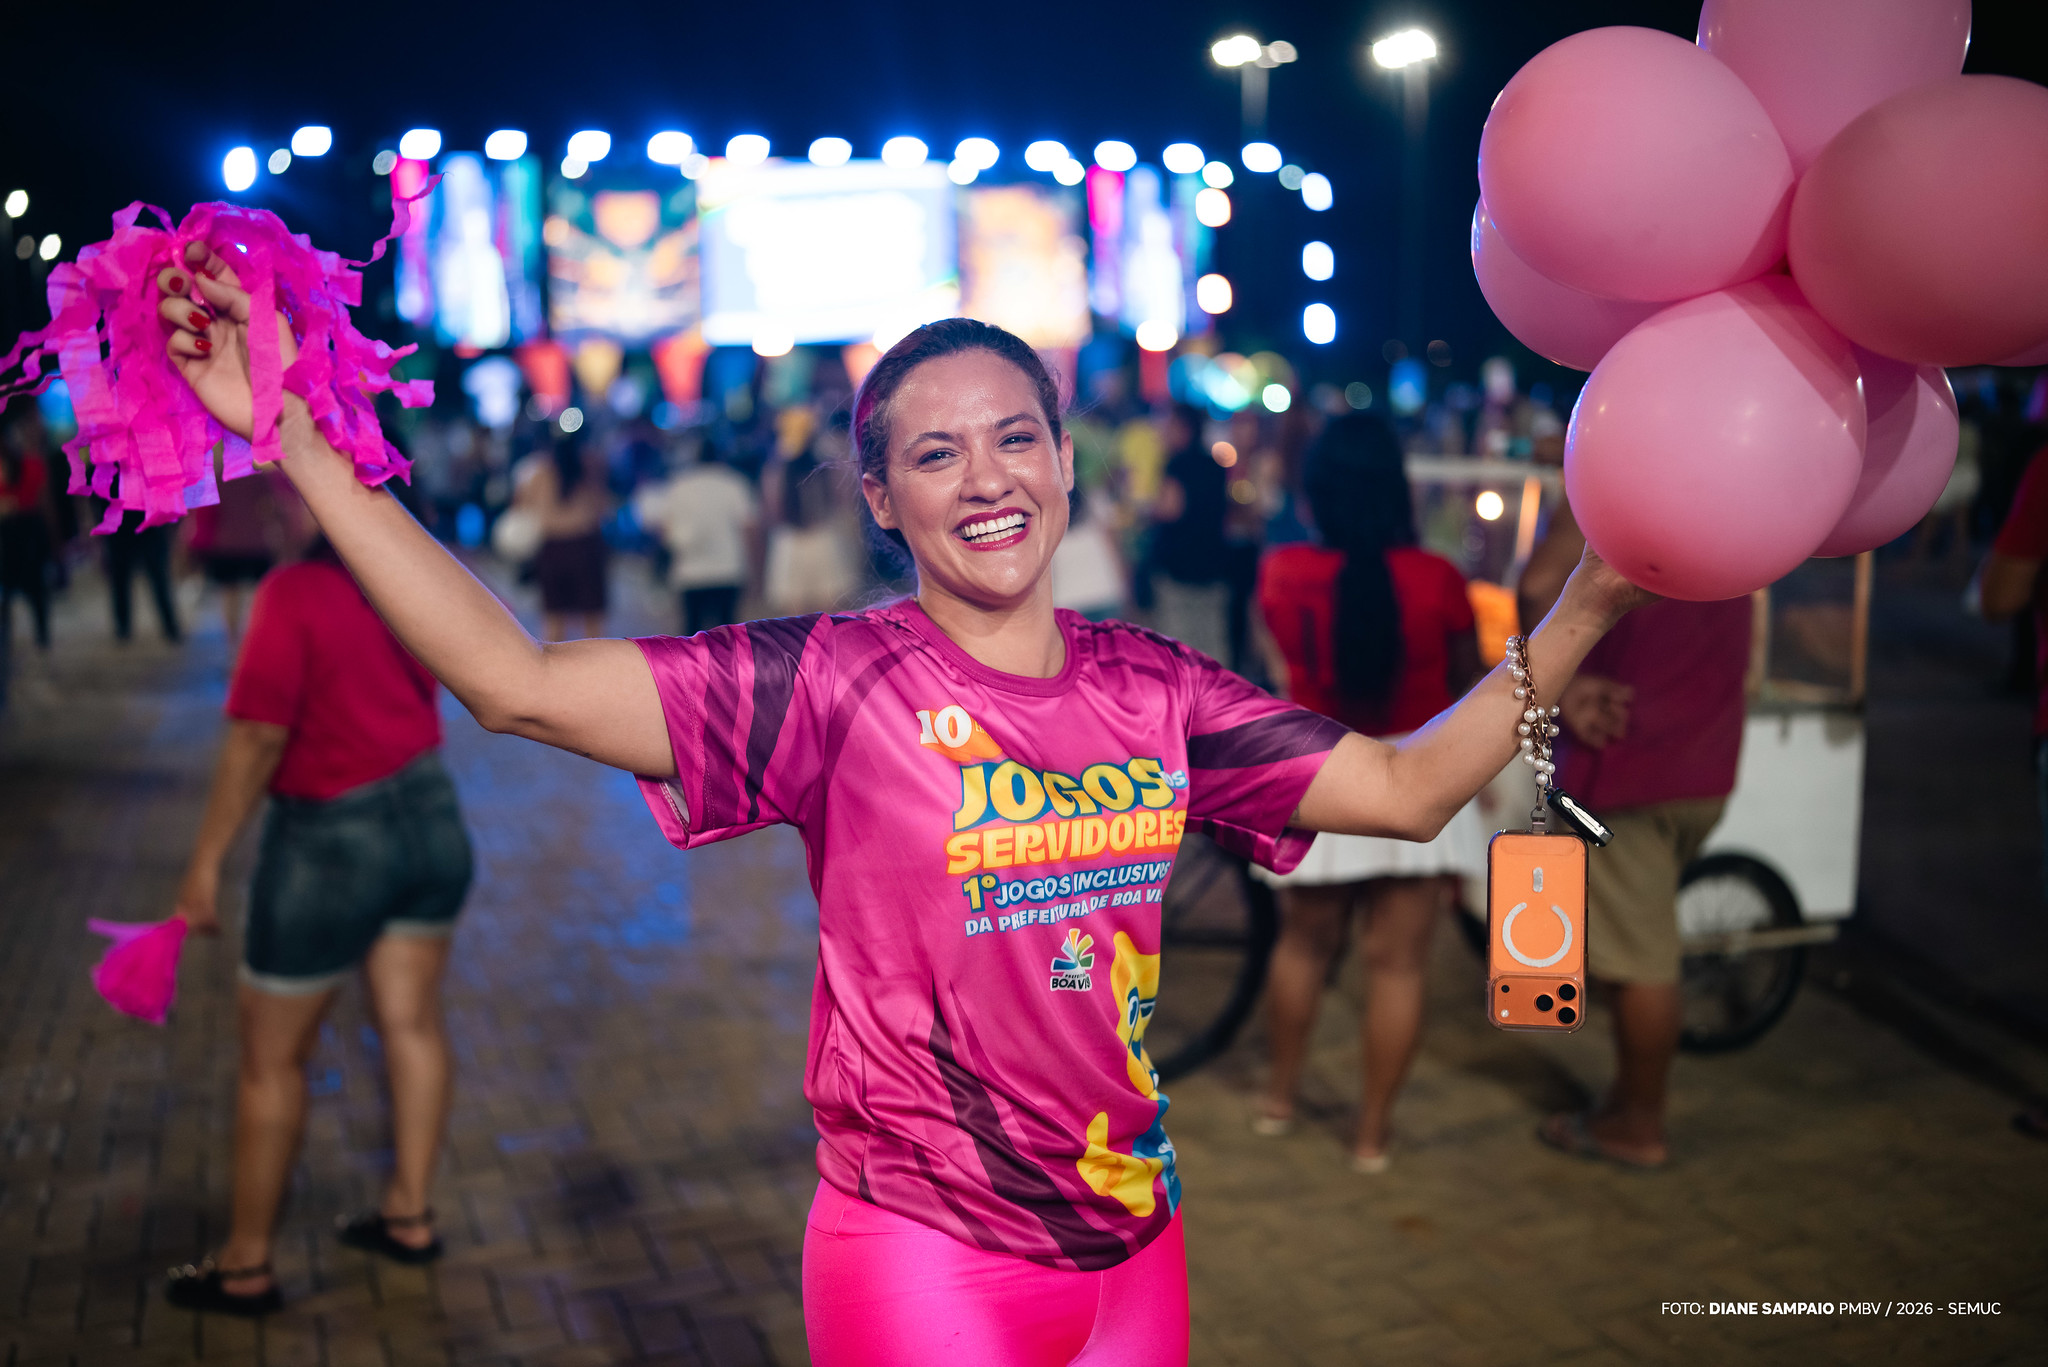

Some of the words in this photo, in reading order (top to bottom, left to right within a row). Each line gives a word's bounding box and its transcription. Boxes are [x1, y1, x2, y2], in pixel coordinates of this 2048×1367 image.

[915, 705, 972, 748] 10
[954, 757, 1175, 831] JOGOS
[946, 809, 1187, 874] SERVIDORES
[965, 916, 994, 937] DA
[998, 900, 1090, 931] PREFEITURA
[1090, 894, 1110, 913] DE
[1111, 889, 1142, 907] BOA
[993, 875, 1071, 906] JOGOS
[1052, 977, 1076, 989] BOA
